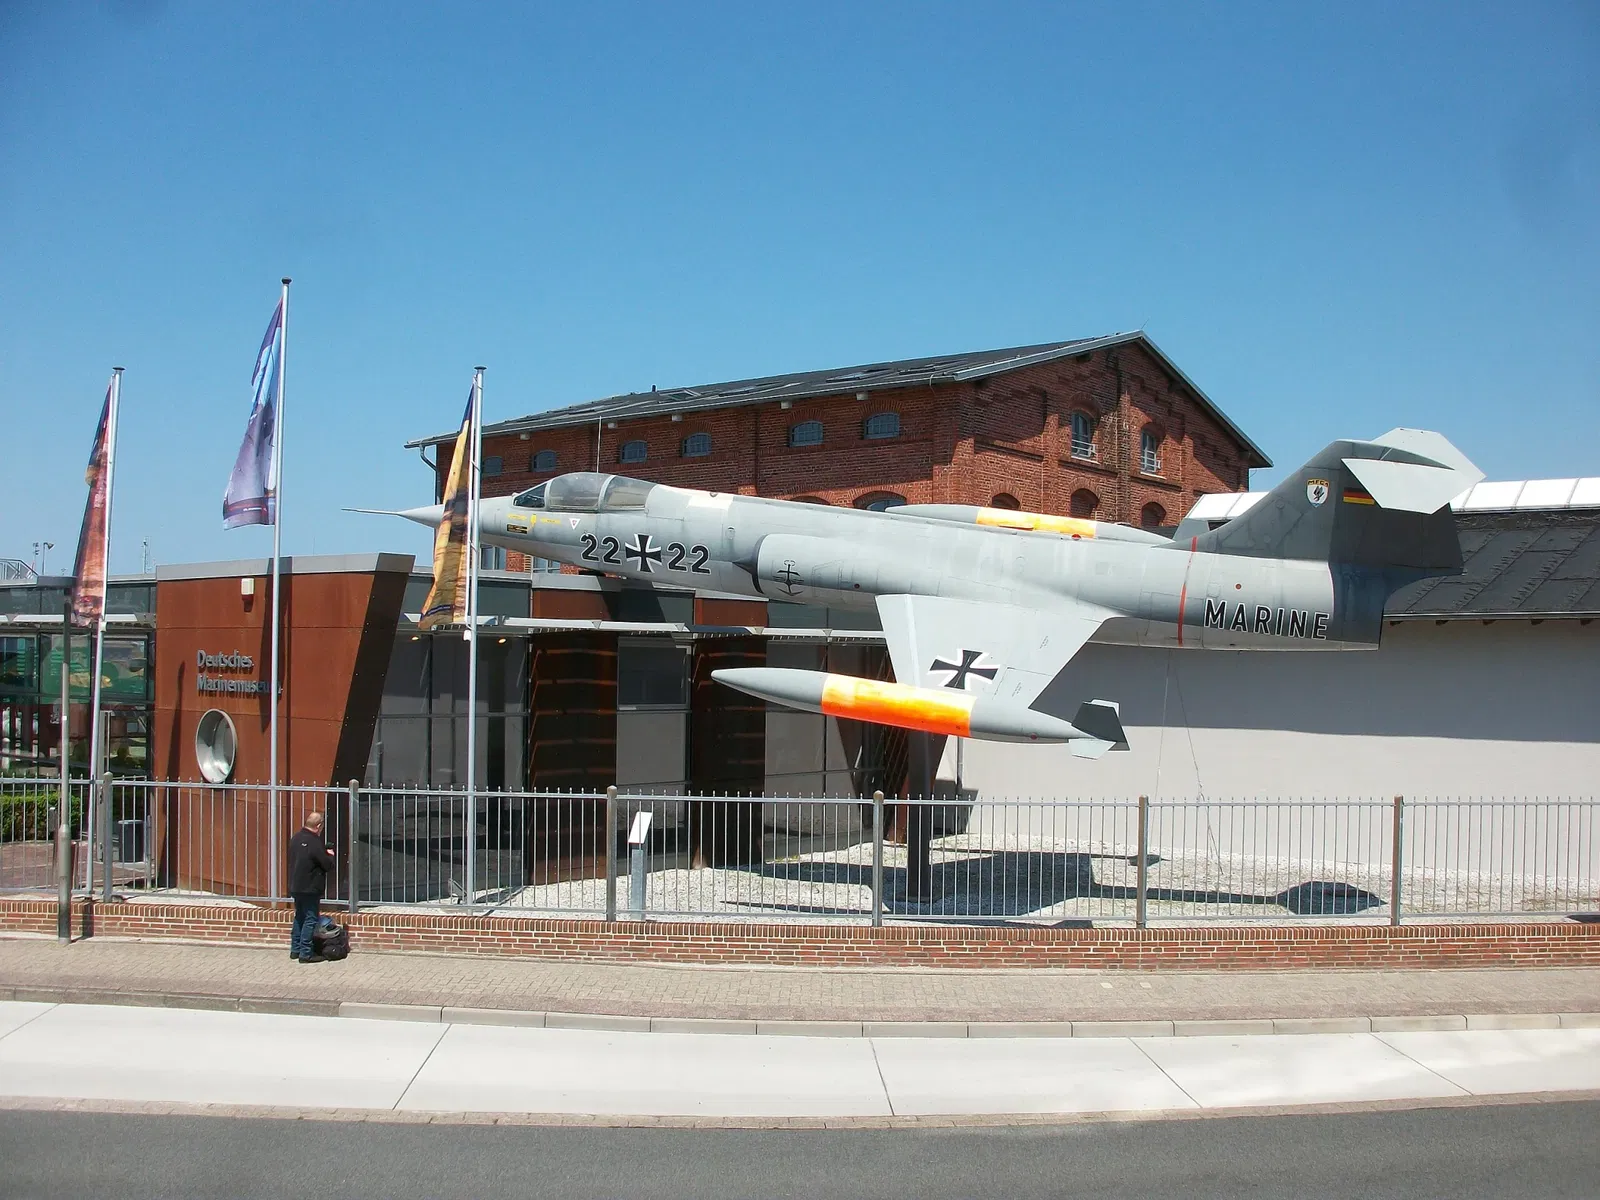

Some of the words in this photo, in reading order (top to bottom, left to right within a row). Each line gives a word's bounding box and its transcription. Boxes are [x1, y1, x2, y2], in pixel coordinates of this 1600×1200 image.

[579, 533, 622, 566] 22
[666, 542, 711, 575] 22
[1204, 598, 1330, 640] MARINE
[197, 649, 253, 668] Deutsches
